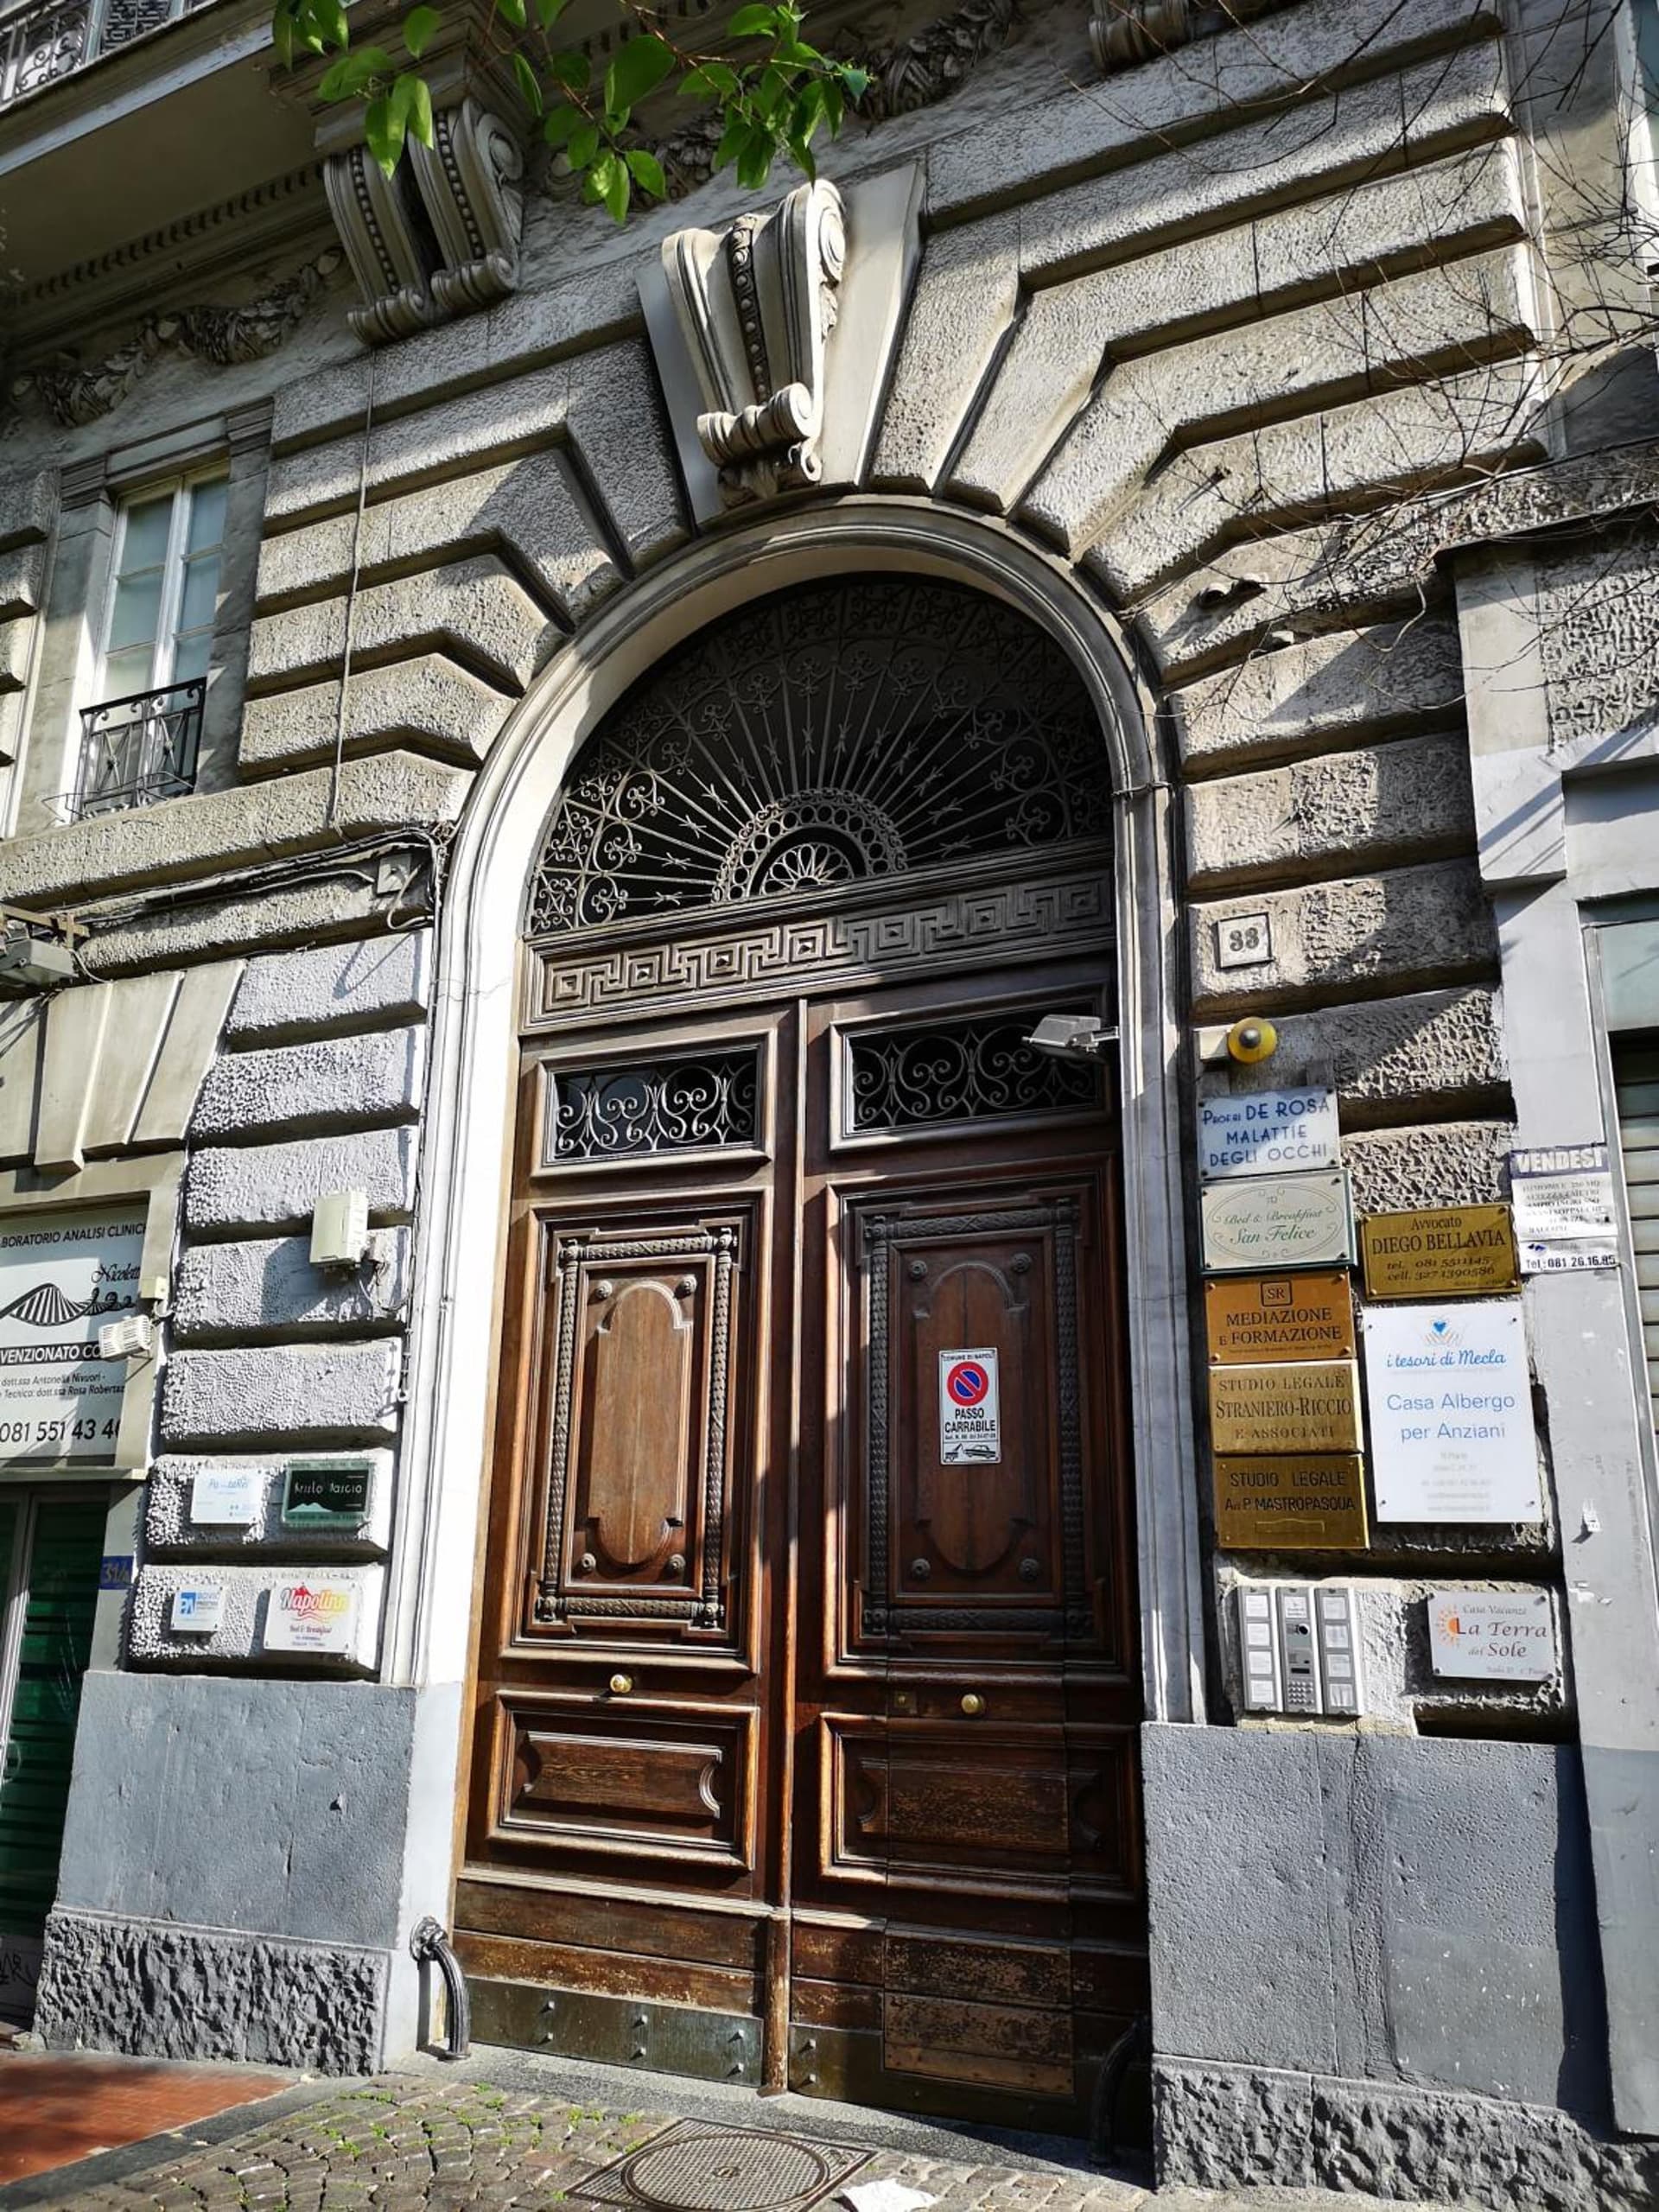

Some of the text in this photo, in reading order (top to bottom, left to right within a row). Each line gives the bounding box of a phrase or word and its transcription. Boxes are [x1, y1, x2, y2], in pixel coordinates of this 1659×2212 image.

[1230, 926, 1260, 952] 33
[1246, 1103, 1268, 1121] DE
[1275, 1097, 1330, 1117] ROSA
[1227, 1124, 1307, 1145] MALATTIE
[1210, 1143, 1327, 1166] DEGLI OCCHI
[1516, 1147, 1603, 1173] VENDESI
[1224, 1214, 1249, 1225] Bed
[1267, 1209, 1323, 1224] Breakfast
[1410, 1216, 1462, 1231] Avvocato
[0, 1231, 60, 1249] BORATORIO
[63, 1226, 105, 1242] ANALISI
[1230, 1224, 1316, 1245] San Felice
[1372, 1229, 1506, 1255] DIEGO BELLAVIA
[1415, 1258, 1438, 1268] 081
[1267, 1287, 1286, 1300] SR
[1226, 1307, 1332, 1327] MEDIAZIONE
[1219, 1325, 1343, 1345] E FORMAZIONE
[0, 1344, 79, 1364] VENZIONATO
[1395, 1351, 1437, 1368] tesori
[1440, 1350, 1455, 1366] di
[1218, 1375, 1345, 1392] STUDIO LEGALE
[955, 1407, 985, 1419] PASSO
[1216, 1397, 1352, 1419] STRANIERO-RICCIO
[1387, 1393, 1516, 1413] Casa Albergo
[0, 1421, 31, 1443] 081
[36, 1421, 67, 1441] 551
[72, 1418, 97, 1440] 43
[944, 1420, 996, 1433] CARRABILE
[1235, 1427, 1335, 1440] E ASSOCIATI
[1401, 1422, 1506, 1443] per Anziani
[1230, 1471, 1348, 1487] STUDIO LEGALE
[1255, 1496, 1356, 1511] MASTROPASQUA
[1462, 1605, 1486, 1615] Casa
[1456, 1617, 1548, 1638] La Terra
[1487, 1642, 1528, 1658] Sole
